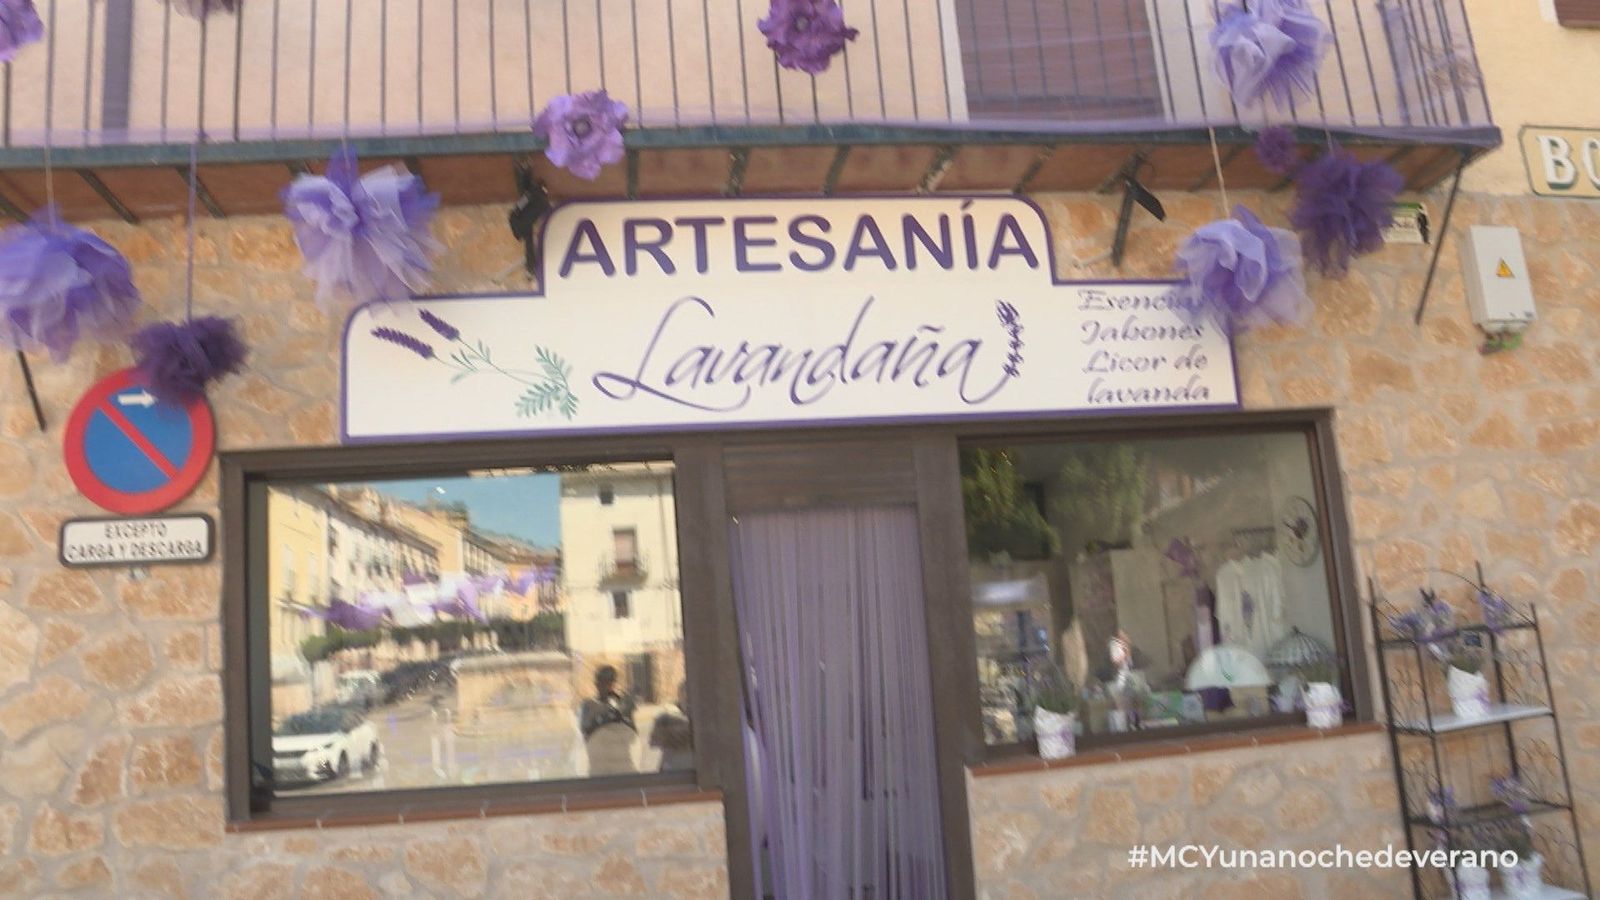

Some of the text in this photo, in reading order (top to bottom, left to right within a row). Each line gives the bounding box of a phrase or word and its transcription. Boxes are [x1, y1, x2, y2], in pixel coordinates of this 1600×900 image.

[558, 199, 1040, 278] ARTESANÍA
[1081, 314, 1204, 345] Jabones
[592, 295, 1014, 412] Lavandaña
[1082, 343, 1208, 374] Licor de
[1087, 373, 1210, 404] lavanda
[104, 521, 168, 539] EXCEPTO
[67, 543, 115, 561] CARGA
[129, 539, 203, 558] DESCARGA
